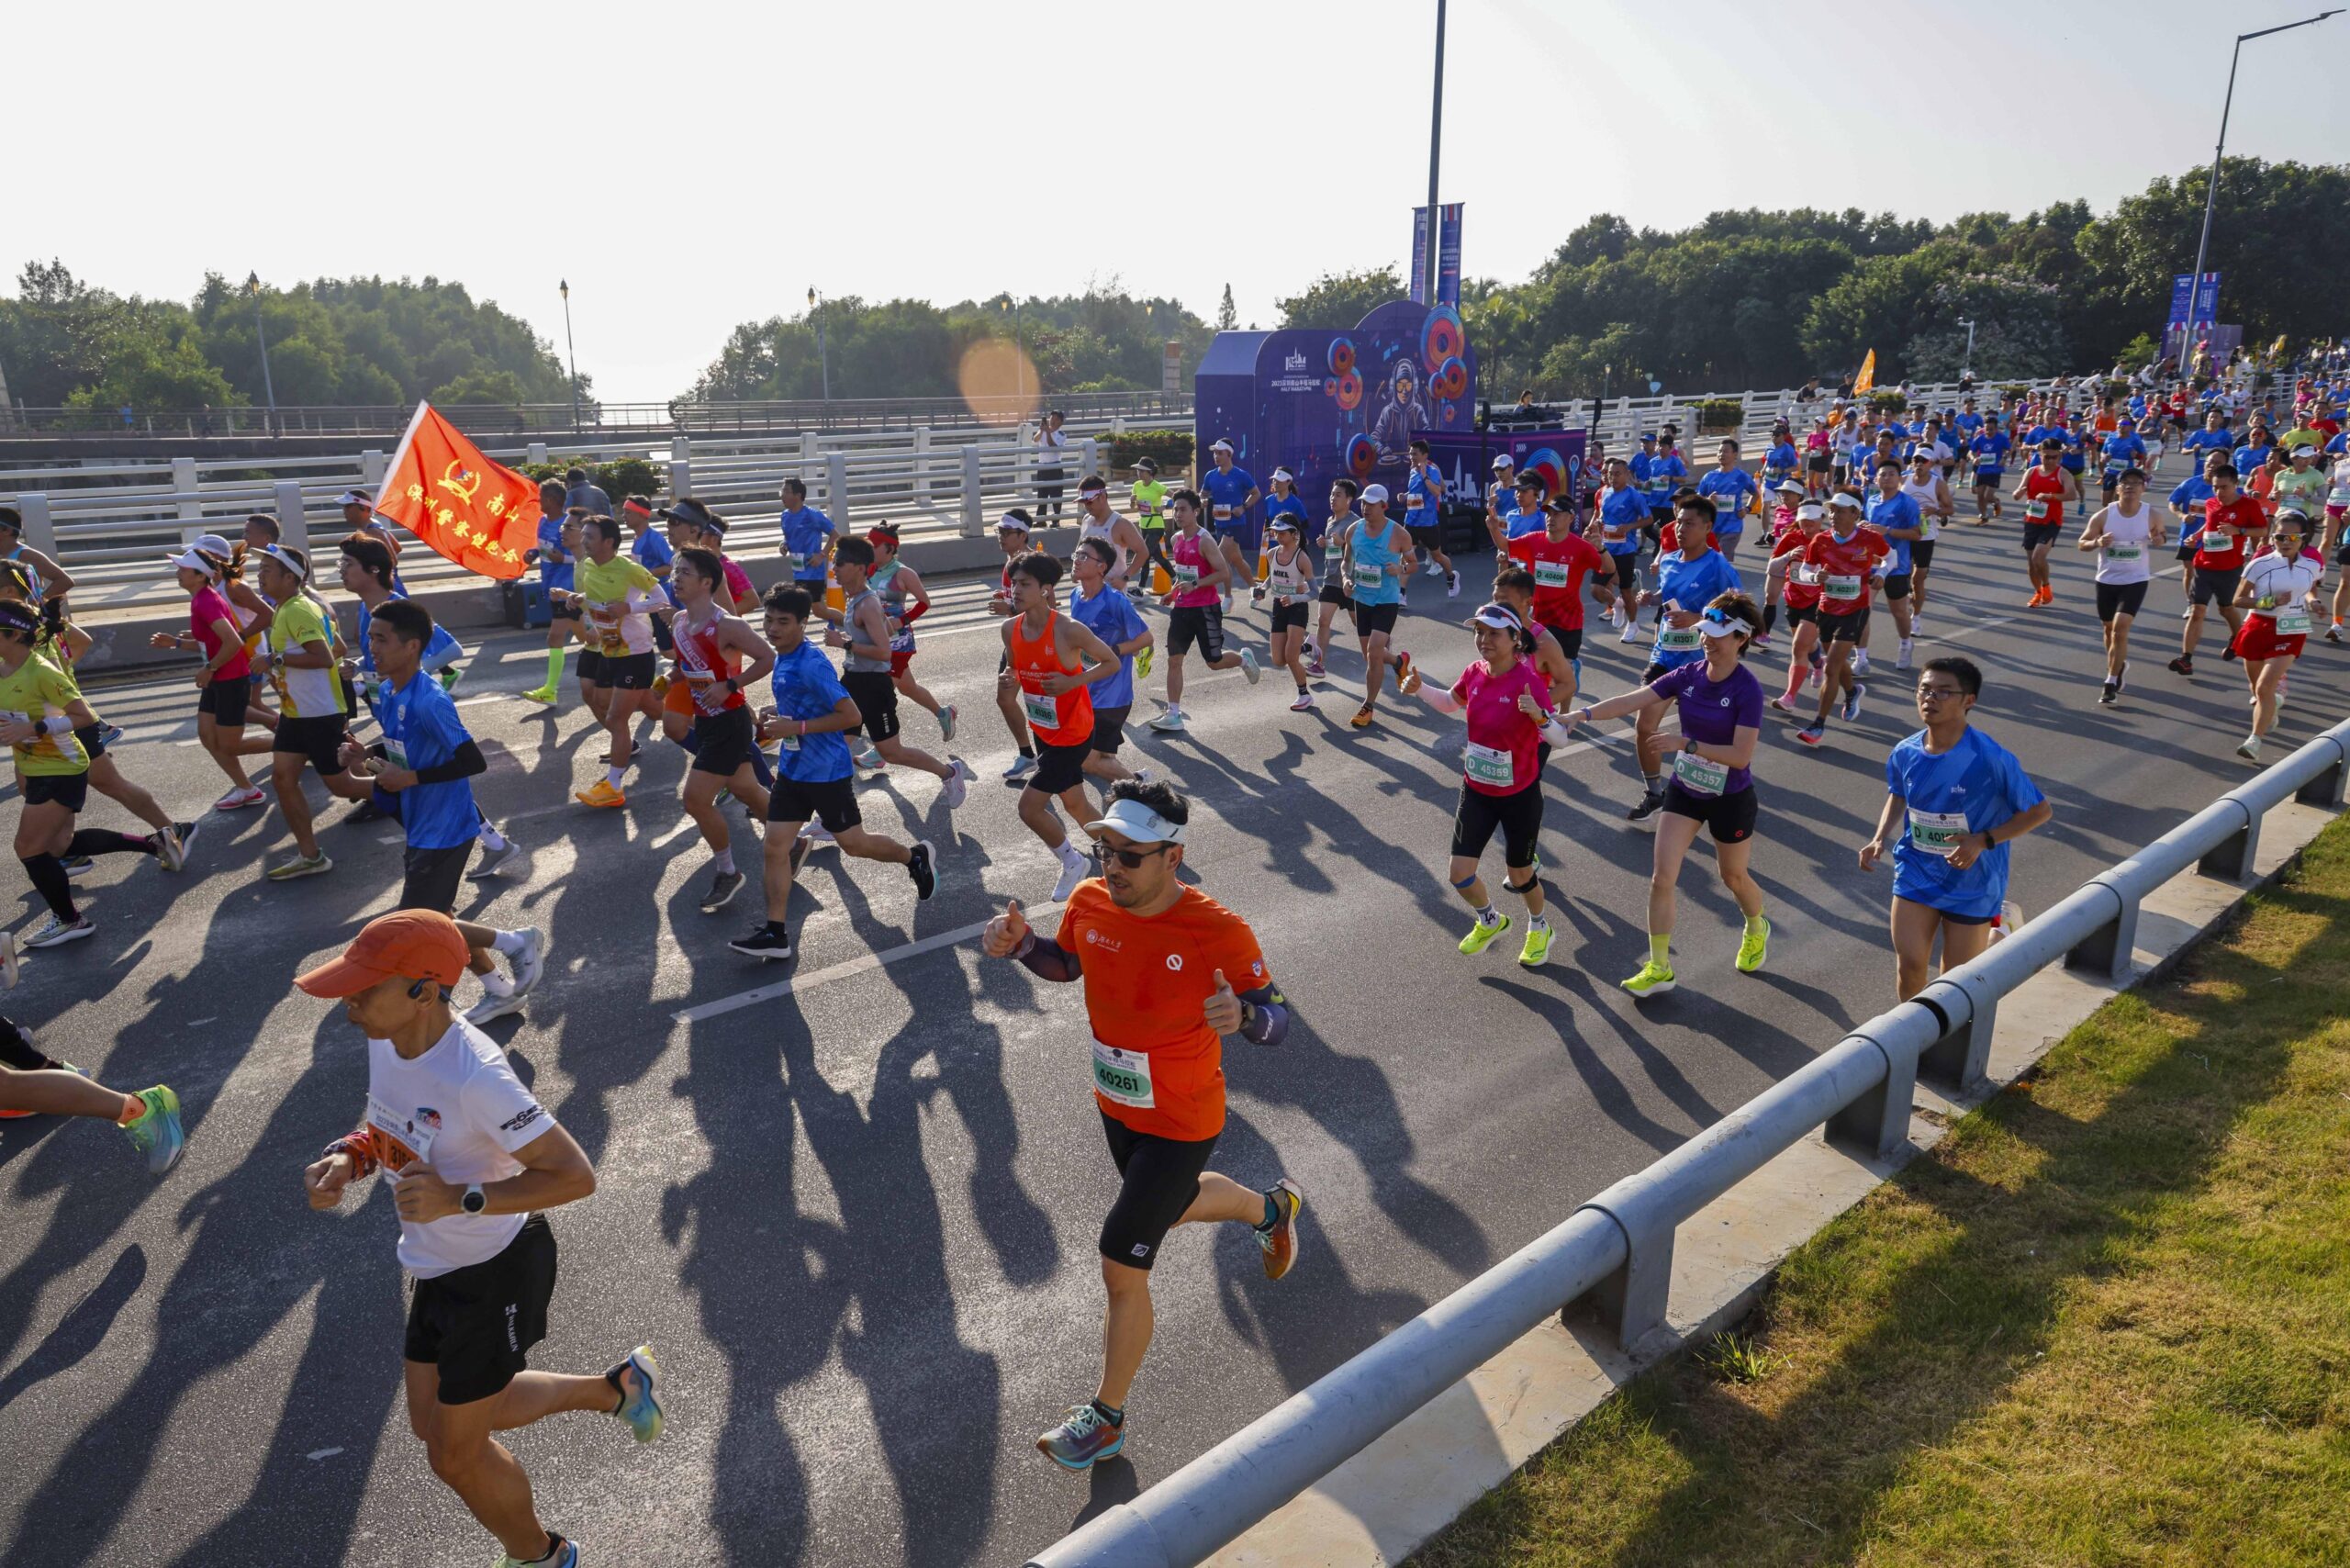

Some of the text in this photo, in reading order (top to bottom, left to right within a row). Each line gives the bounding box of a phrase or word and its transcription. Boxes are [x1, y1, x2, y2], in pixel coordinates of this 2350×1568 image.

[2281, 620, 2288, 628] D
[1663, 633, 1669, 643] D
[1469, 758, 1509, 777] D 45359
[1677, 762, 1685, 773] D
[1691, 769, 1721, 787] 45357
[1914, 826, 1958, 843] D 401
[1100, 1069, 1138, 1092] 40261
